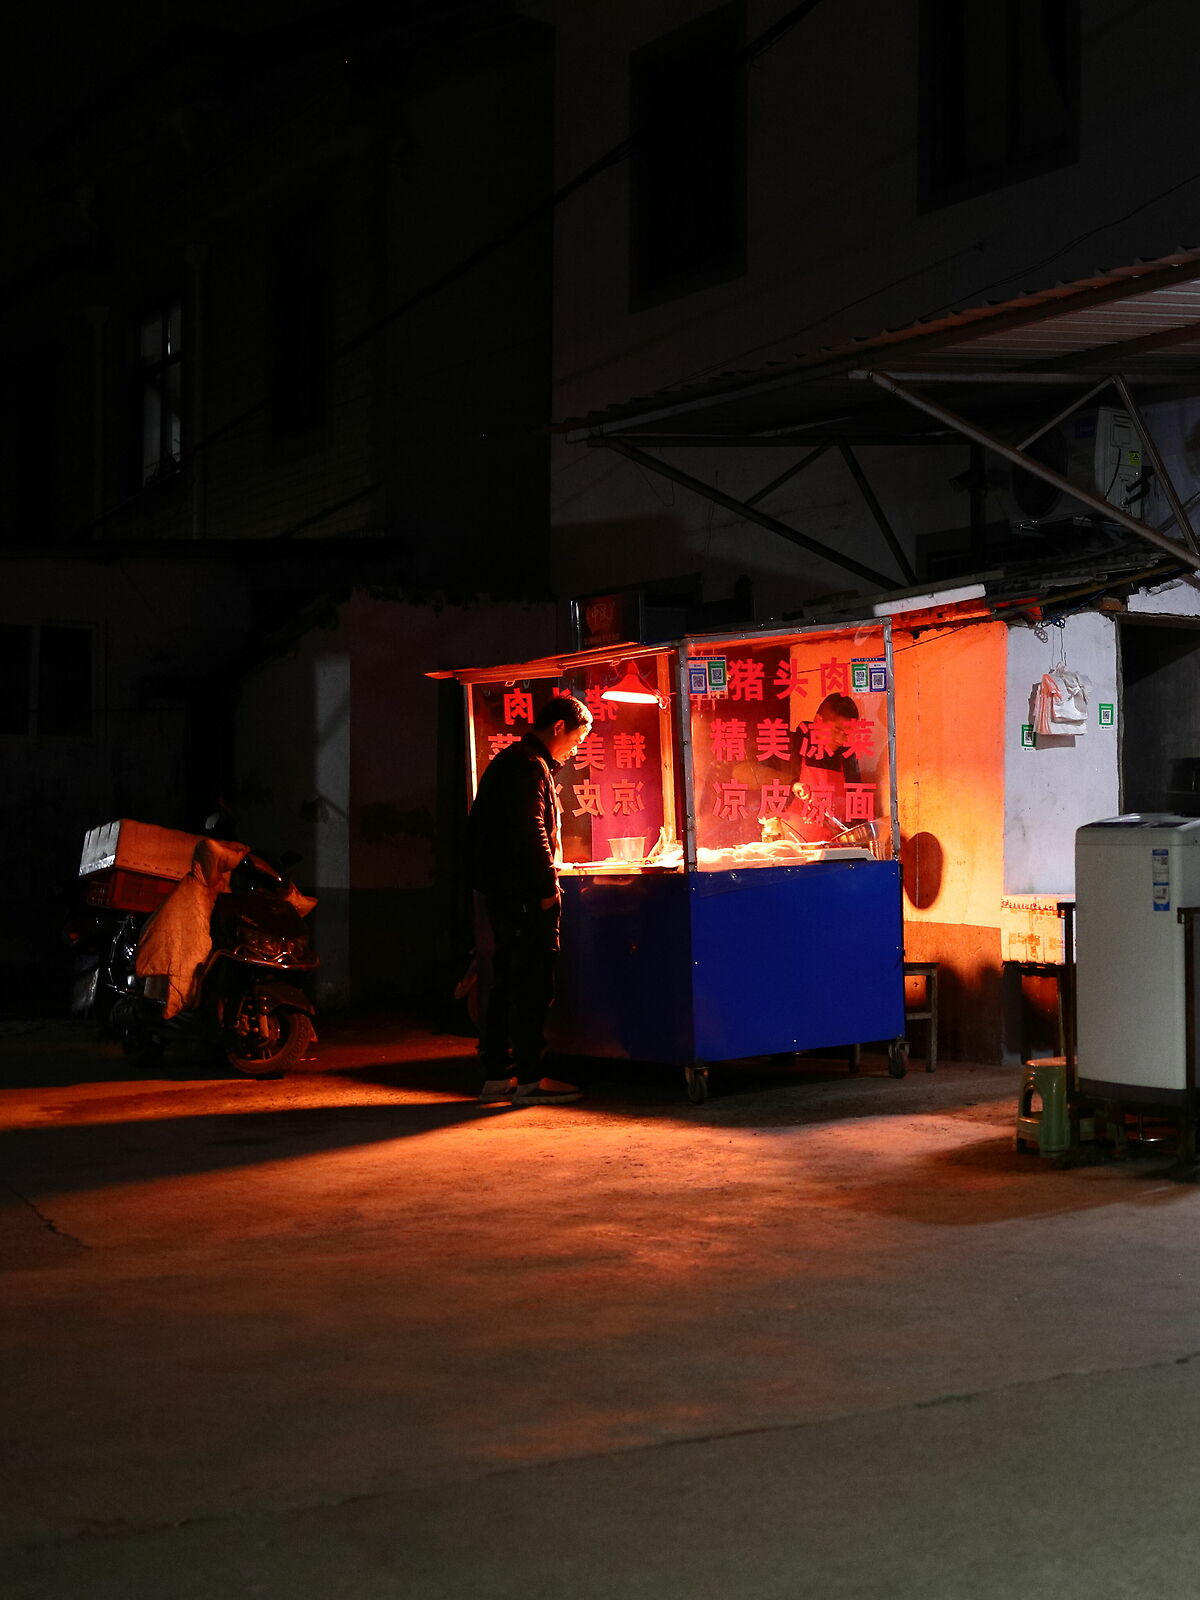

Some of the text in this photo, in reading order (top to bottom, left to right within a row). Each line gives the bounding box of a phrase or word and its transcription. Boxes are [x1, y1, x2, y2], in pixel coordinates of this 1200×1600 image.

[728, 657, 849, 701] 猪头肉
[710, 718, 876, 761] 精美凉菜
[712, 778, 877, 826] 凉皮凉面
